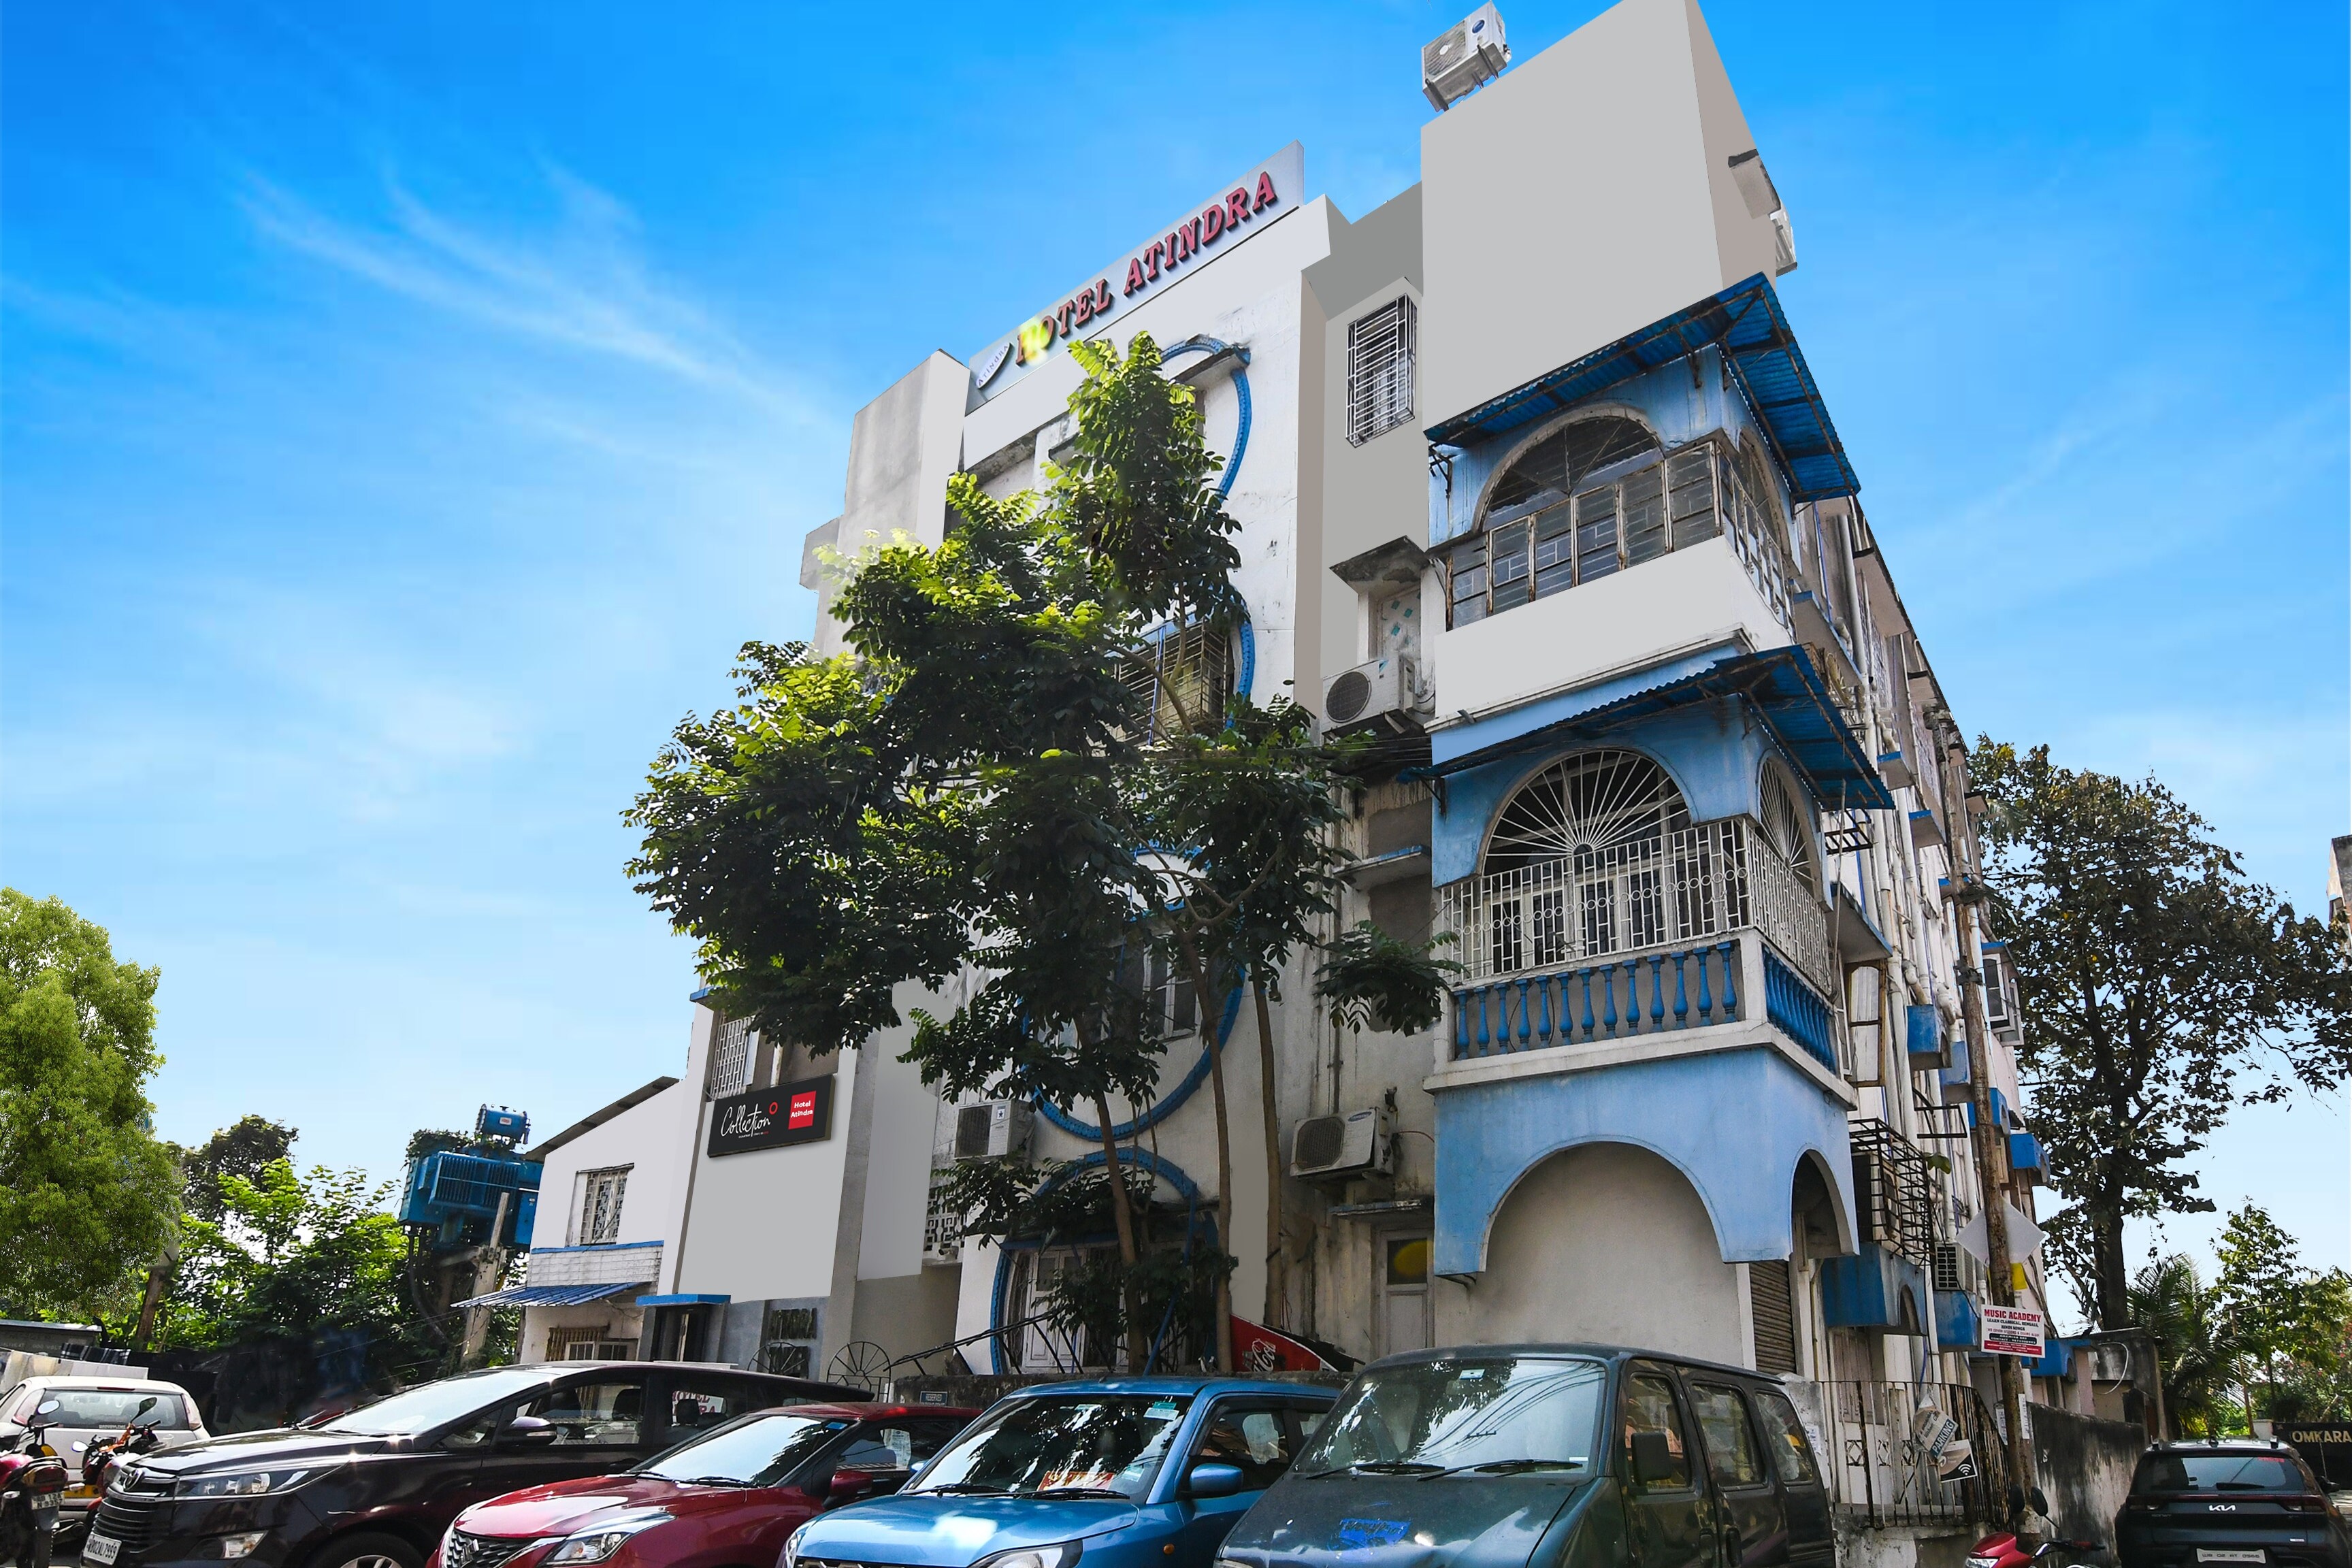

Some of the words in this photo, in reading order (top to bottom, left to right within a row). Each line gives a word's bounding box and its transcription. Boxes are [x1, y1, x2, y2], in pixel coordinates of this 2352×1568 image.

[1123, 172, 1277, 298] ATINDRA
[794, 1100, 811, 1109] Hotel
[721, 1102, 770, 1137] Collection
[790, 1109, 813, 1118] Atindra
[1984, 1309, 2007, 1319] MUSIC
[2009, 1311, 2041, 1322] ACADEMY
[1931, 1420, 1955, 1454] PARKING
[2291, 1431, 2352, 1443] OMKARA
